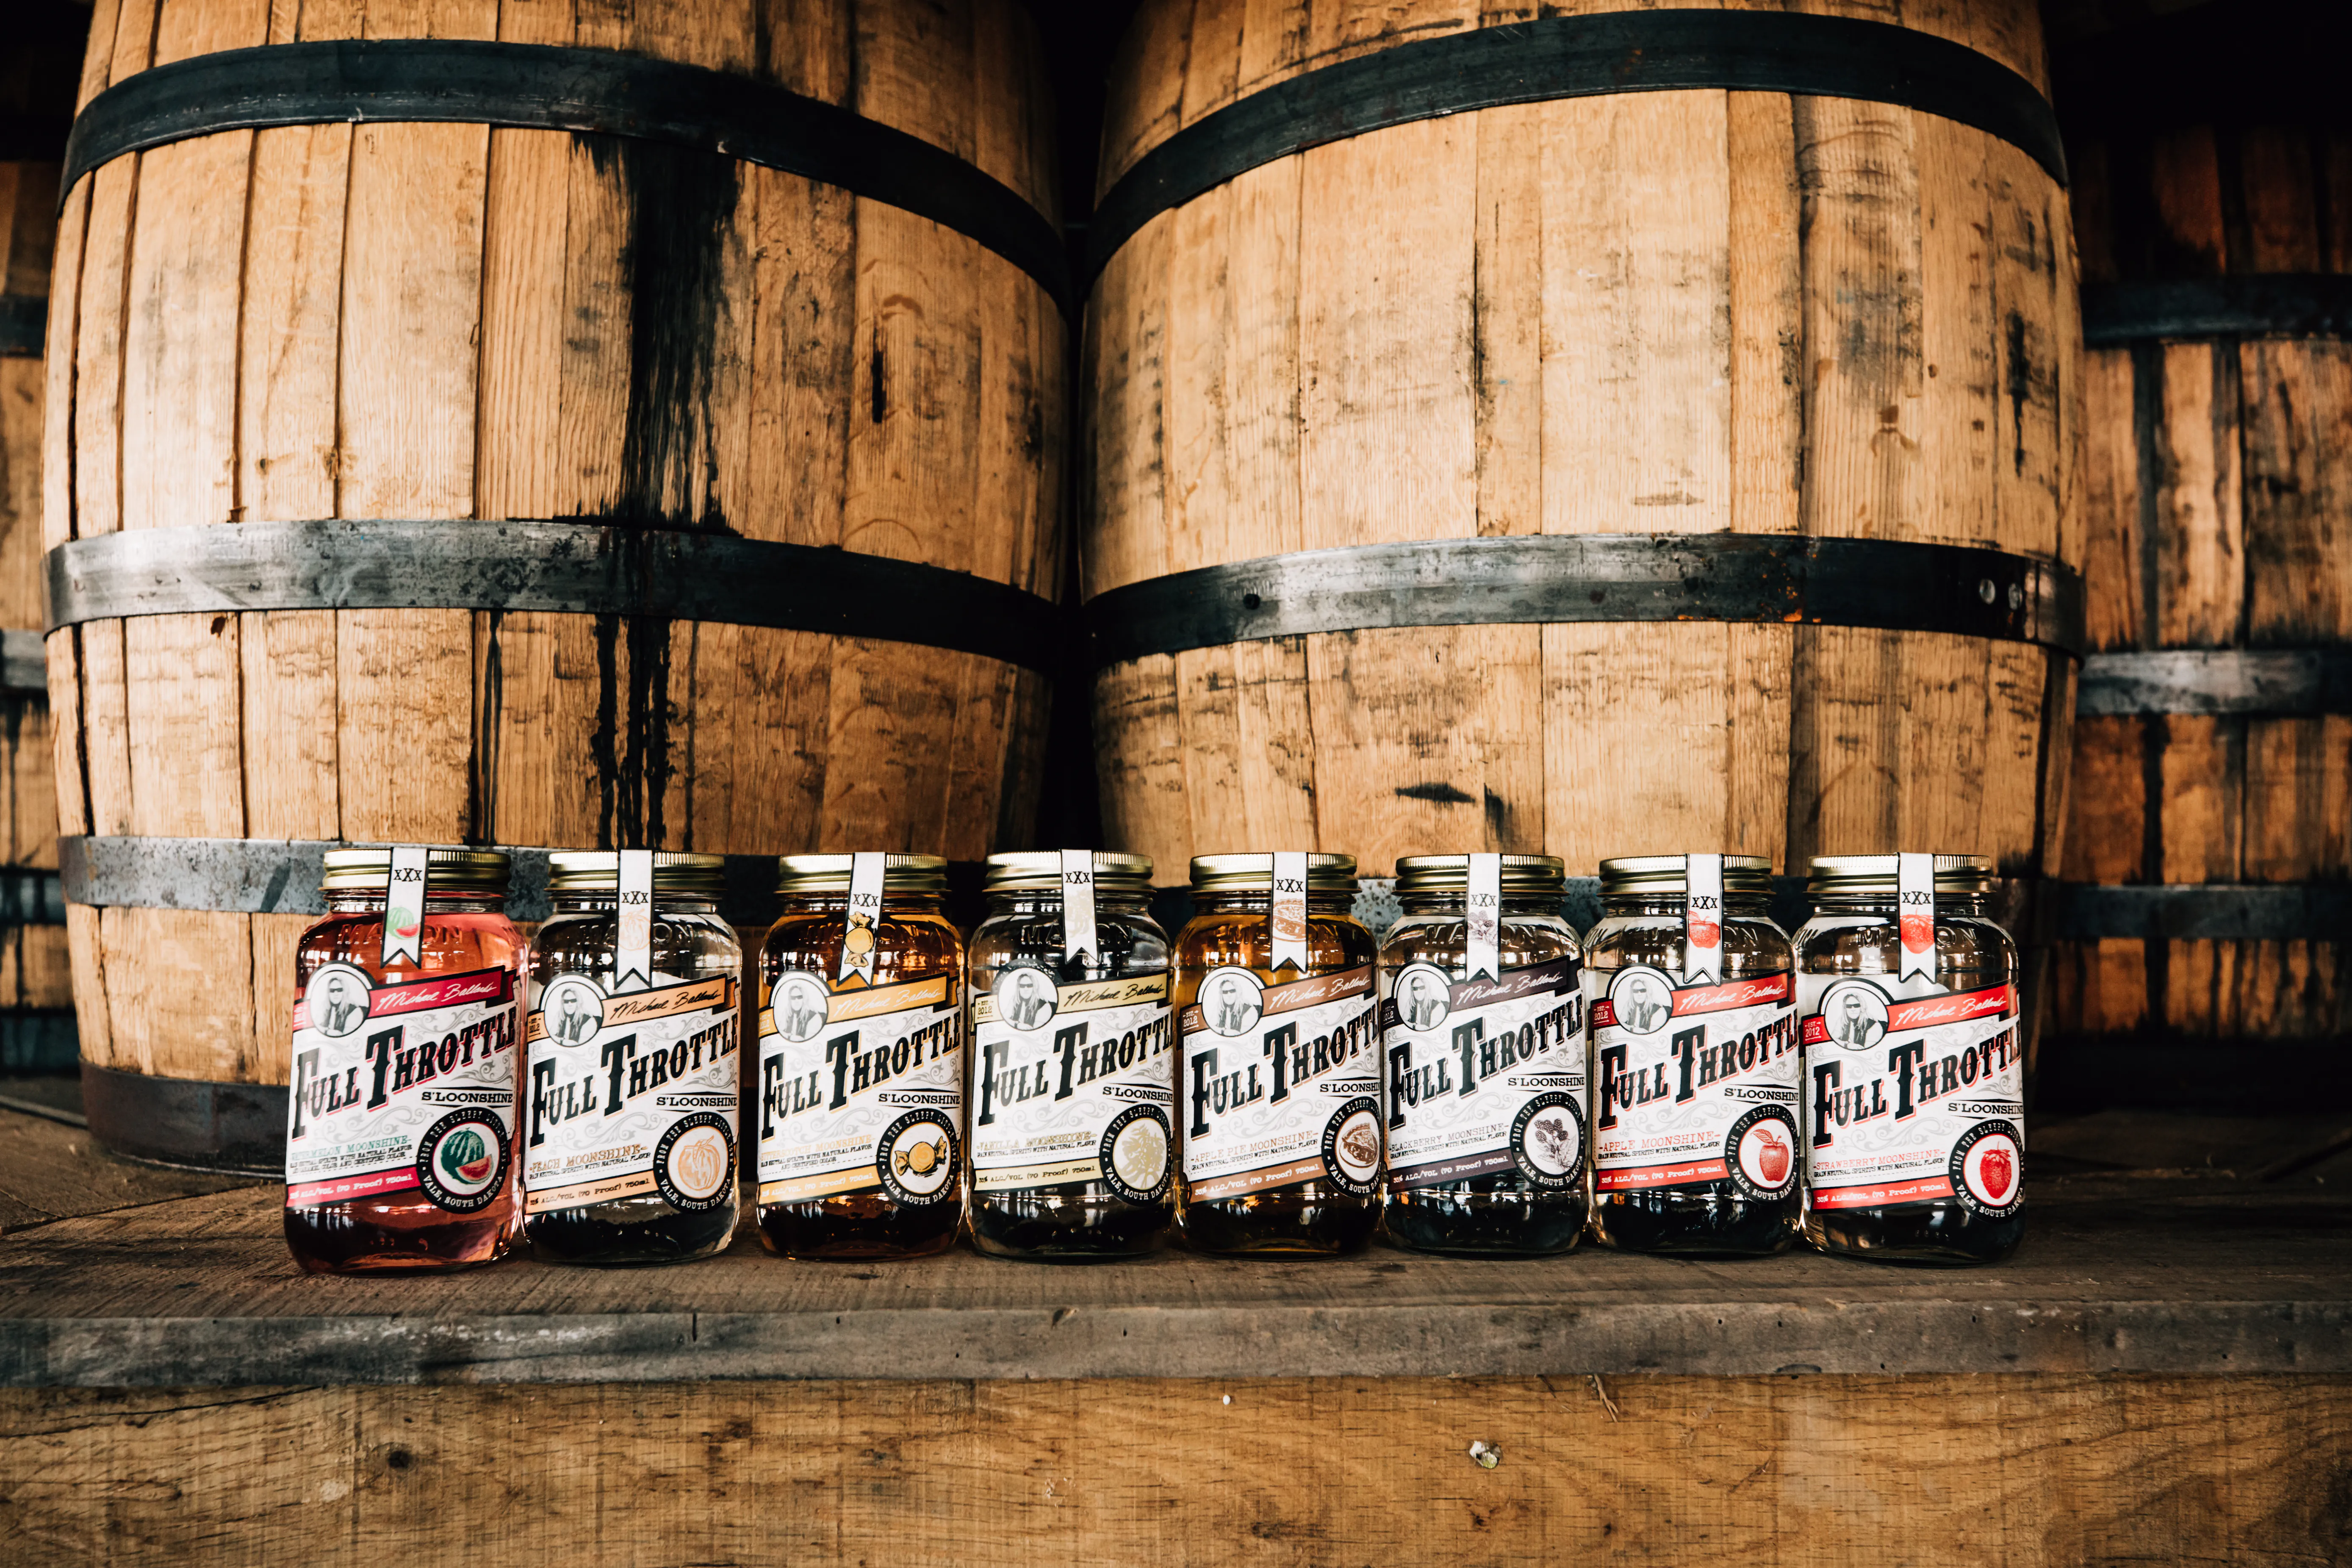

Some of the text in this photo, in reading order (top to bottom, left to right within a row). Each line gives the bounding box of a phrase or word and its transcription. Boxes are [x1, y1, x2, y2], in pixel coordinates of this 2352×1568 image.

[337, 923, 463, 945] MAON
[1183, 1015, 1197, 1027] 2012
[1594, 1011, 1608, 1020] 2012
[1805, 1027, 1820, 1037] 2012
[292, 1005, 517, 1142] FULL THROTTLE
[1389, 1042, 1453, 1131] FULL
[1452, 994, 1583, 1099] THROTTLE
[529, 1013, 738, 1151] FULL THROTTLE
[762, 1011, 961, 1143] FULL THROTTLE
[978, 1040, 1050, 1127] FULL
[1320, 1083, 1380, 1093] S'LOONSHIN
[1508, 1076, 1585, 1087] S'LOONSHINE
[1599, 1044, 1671, 1131] FULL
[422, 1092, 513, 1103] S'LOONSHINE
[657, 1097, 737, 1107] S'LOONSHINE
[878, 1093, 960, 1105] S'LOONSHINE
[1191, 1047, 1265, 1141] FULL
[1724, 1088, 1799, 1101] S'LOONSHINE
[1814, 1060, 1889, 1150] FULL
[850, 1144, 872, 1152] FLAVOR
[1227, 1144, 1247, 1156] PIE
[1230, 1153, 1253, 1163] SPIRITS
[1271, 1144, 1297, 1154] NATURAL
[1298, 1139, 1318, 1148] FLAVOR
[1042, 1169, 1068, 1177] Proof)
[1266, 1169, 1292, 1182] Proof)
[1455, 1160, 1481, 1172] Proof)
[1518, 1155, 1536, 1180] VALE,
[1538, 1176, 1563, 1186] SOUTH
[1668, 1168, 1694, 1178] Proof)
[595, 1183, 621, 1194] Proof)
[883, 1172, 954, 1205] VALE, SOUTH DAKOTA
[1105, 1166, 1122, 1192] VALE,
[1124, 1188, 1149, 1200] SOUTH
[1329, 1164, 1370, 1194] VALE, SOUTH
[1732, 1167, 1750, 1192] VALE,
[1752, 1188, 1778, 1200] SOUTH
[423, 1175, 503, 1207] VALE, SOUTH DAKOTA
[660, 1178, 731, 1210] VALE, SOUTH DAKOTA
[1889, 1186, 1917, 1196] Proof)
[1956, 1184, 1977, 1210] VALE,
[1979, 1206, 2006, 1217] SOUTH
